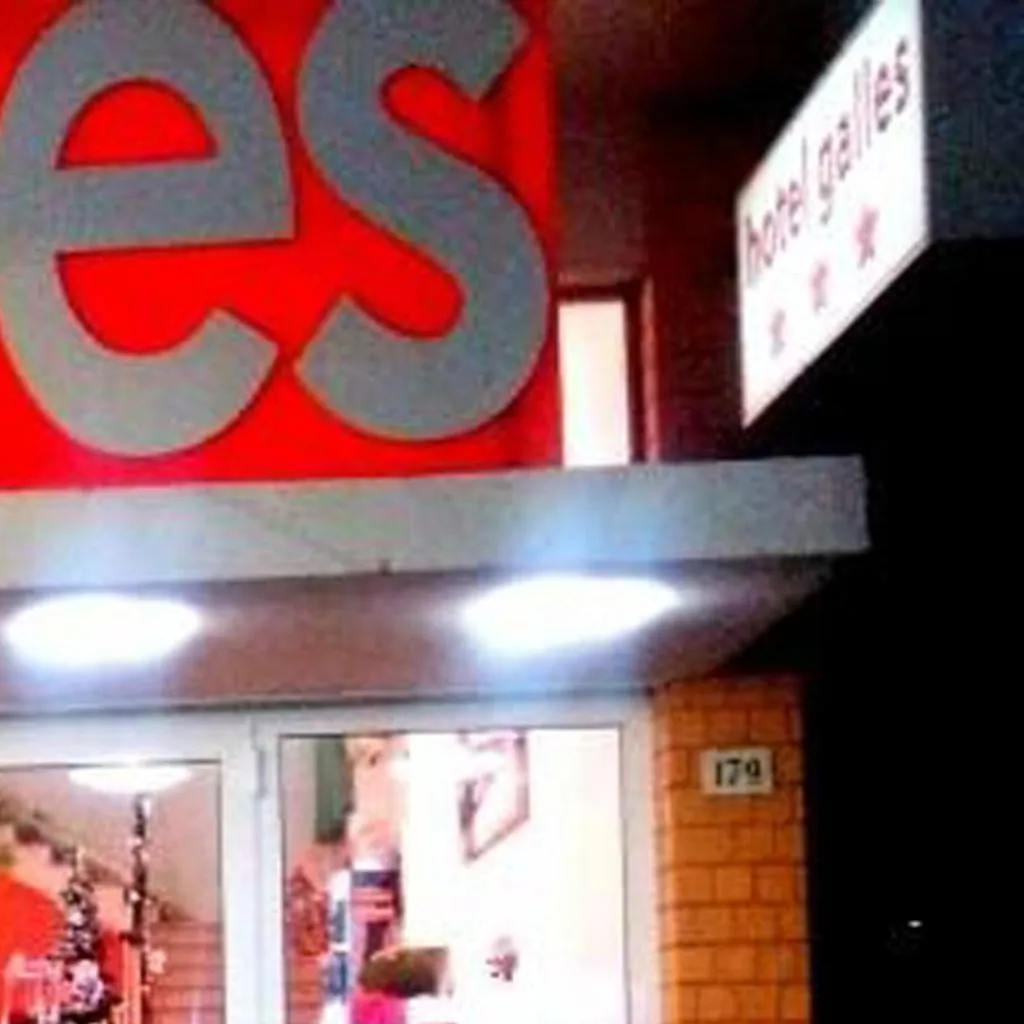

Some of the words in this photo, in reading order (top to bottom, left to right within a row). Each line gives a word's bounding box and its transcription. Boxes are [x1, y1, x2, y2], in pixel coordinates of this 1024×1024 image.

[741, 135, 809, 287] hotel
[818, 35, 911, 225] galles
[714, 757, 762, 787] 179
